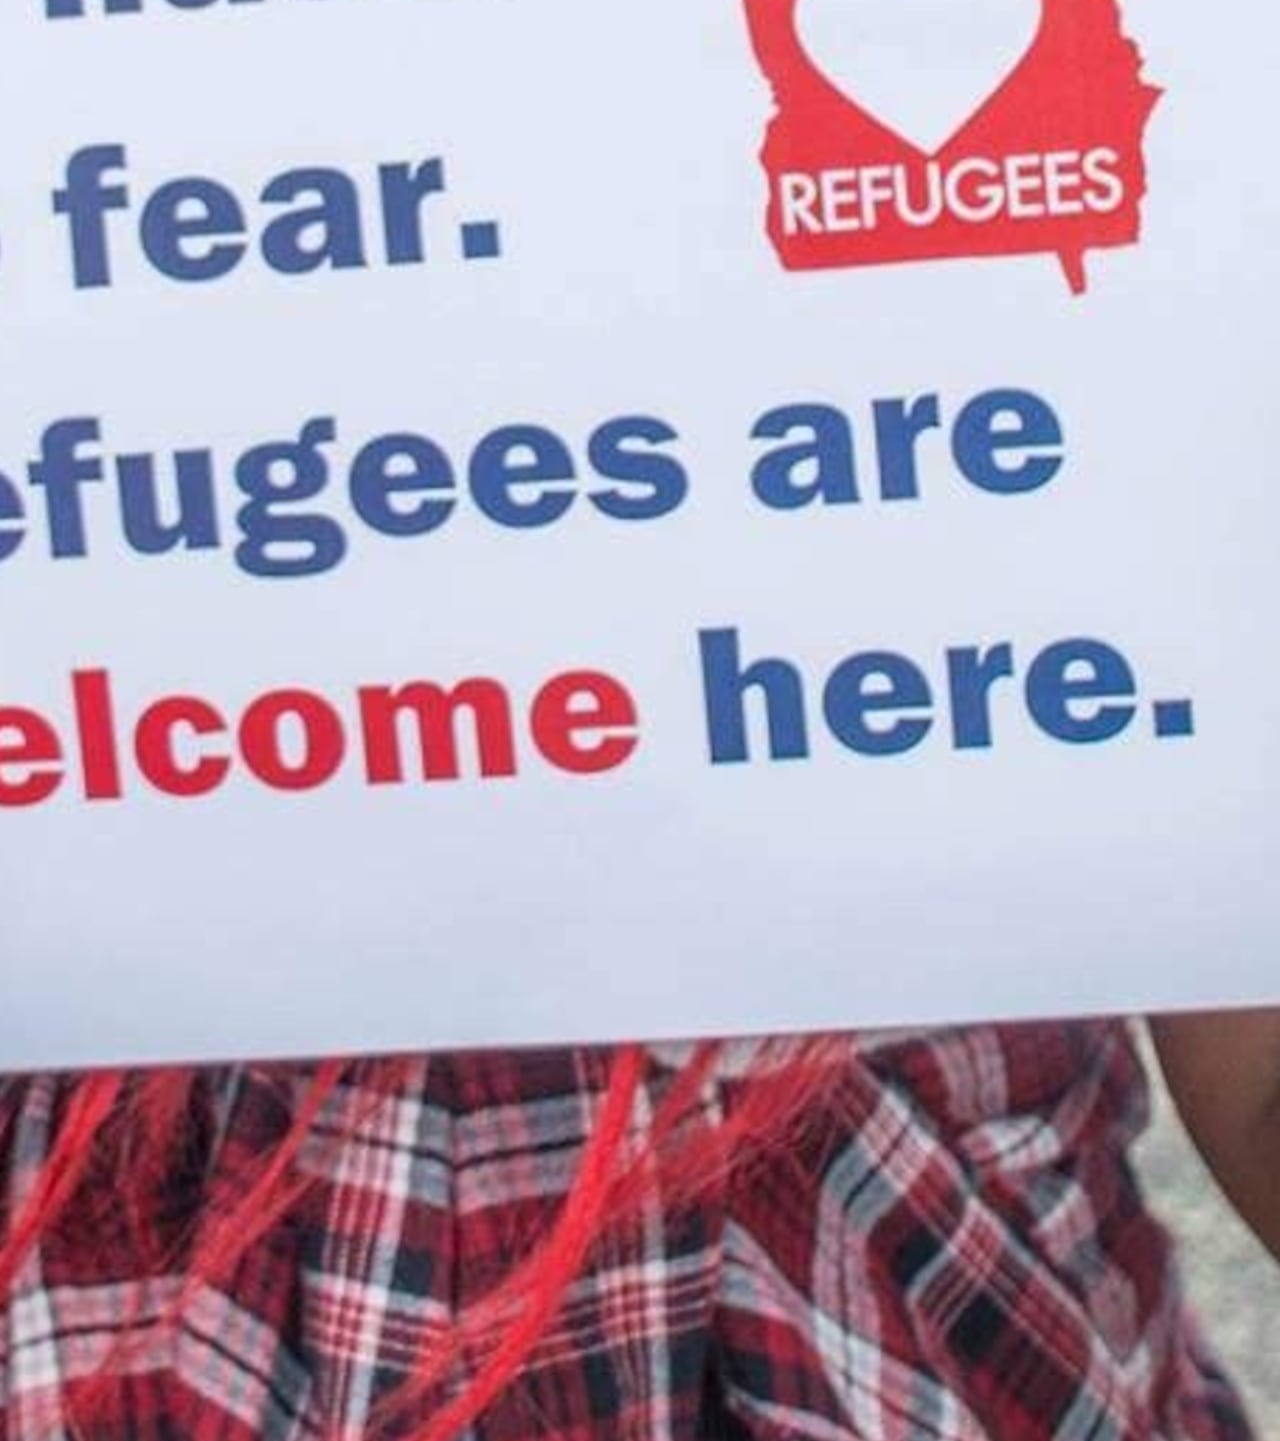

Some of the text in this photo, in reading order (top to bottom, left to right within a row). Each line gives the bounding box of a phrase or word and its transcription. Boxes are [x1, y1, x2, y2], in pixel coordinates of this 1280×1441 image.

[50, 142, 502, 291] fear.
[778, 145, 1125, 235] REFUGEES
[748, 387, 1065, 511] are
[697, 625, 1196, 767] here.
